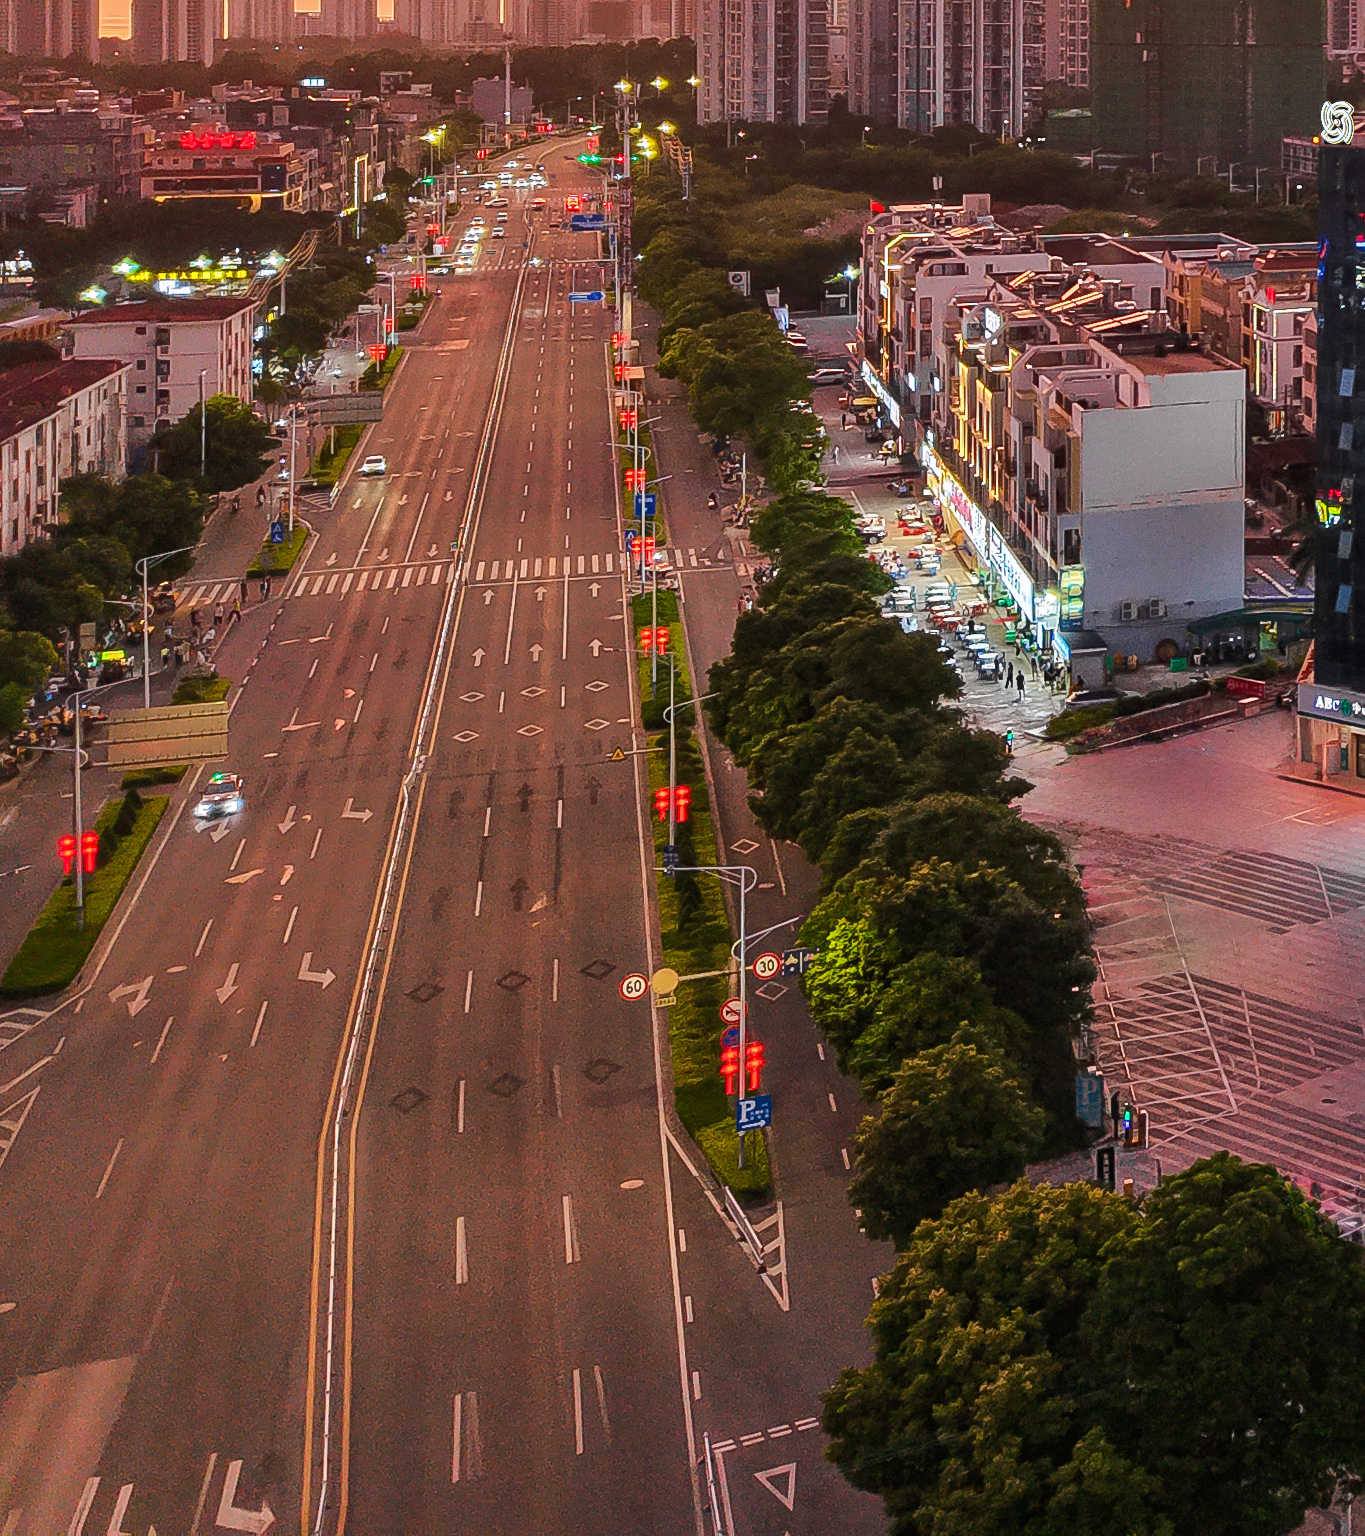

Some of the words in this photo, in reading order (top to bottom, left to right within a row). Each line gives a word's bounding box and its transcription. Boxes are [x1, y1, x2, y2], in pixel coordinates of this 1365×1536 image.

[1315, 695, 1340, 711] ABC
[759, 958, 775, 974] 30
[626, 979, 642, 995] 60
[739, 1100, 757, 1123] P
